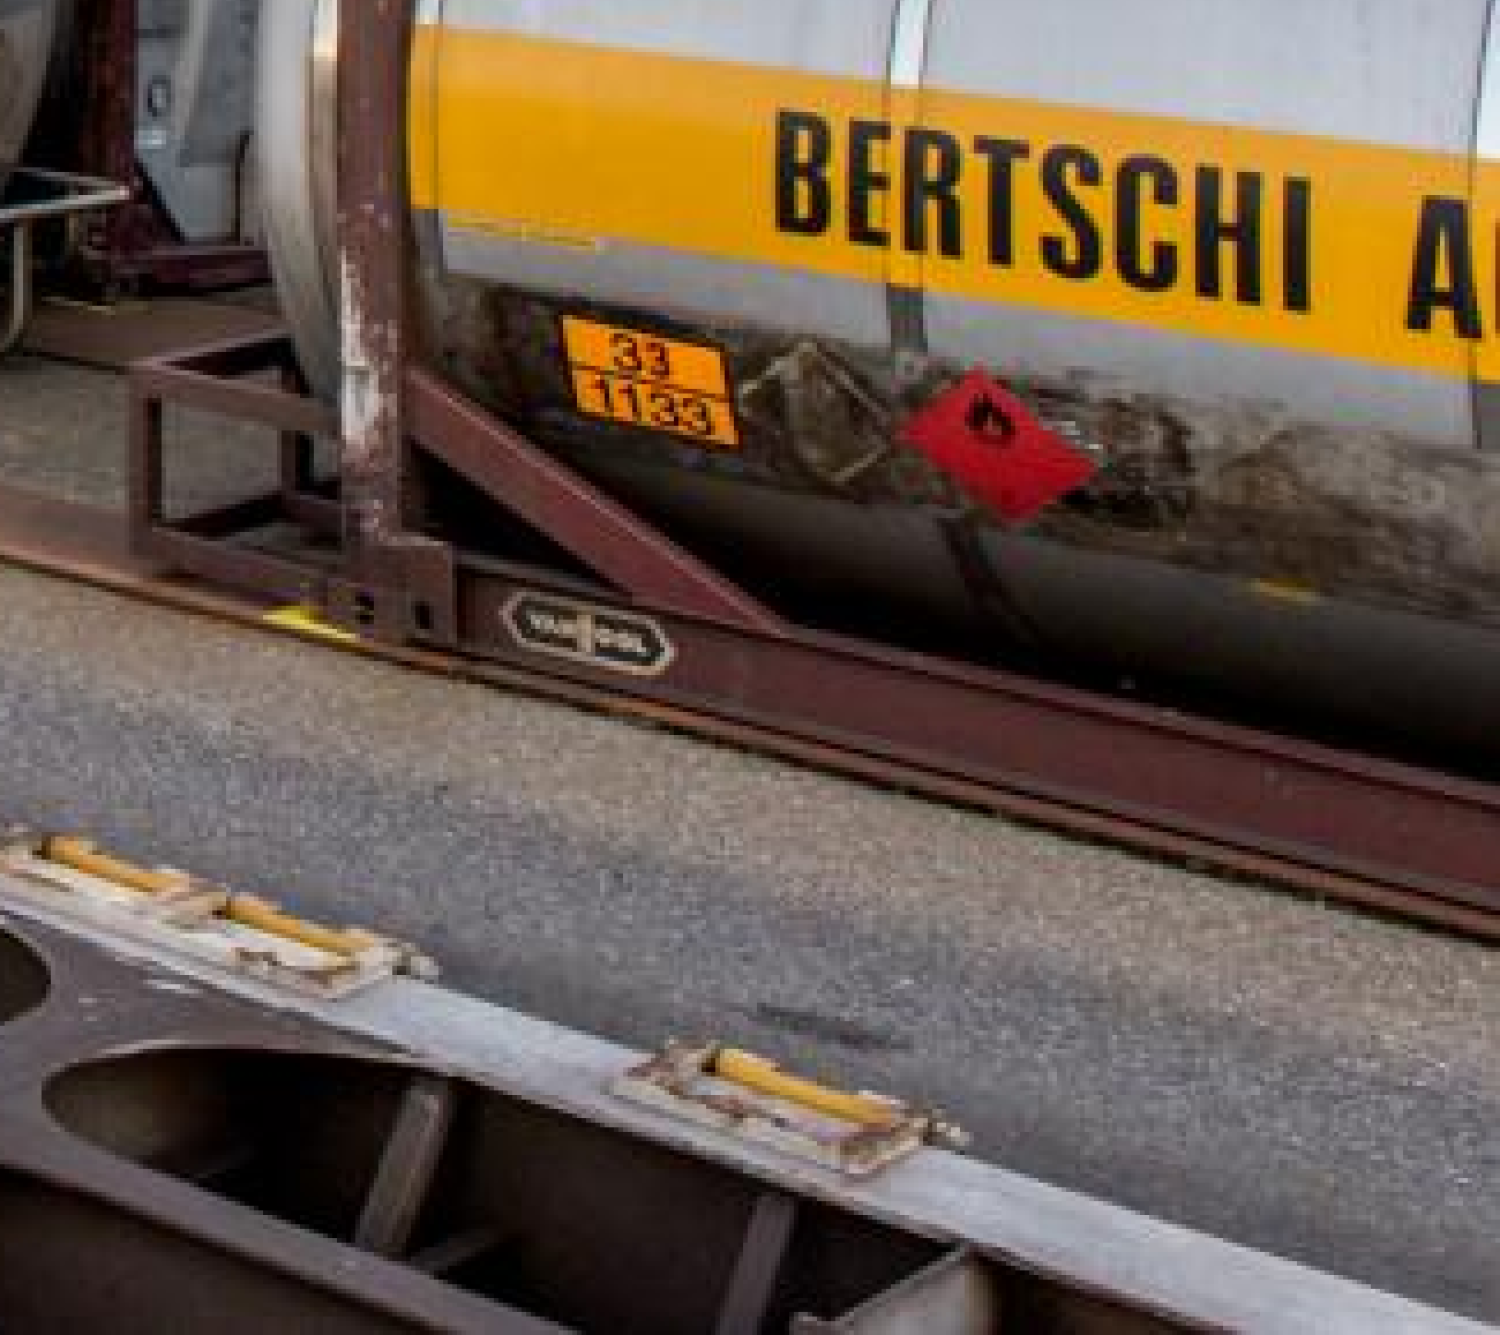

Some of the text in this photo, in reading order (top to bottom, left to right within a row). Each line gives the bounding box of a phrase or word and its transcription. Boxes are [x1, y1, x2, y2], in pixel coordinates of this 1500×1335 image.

[775, 105, 1500, 345] BERTSCHI A
[610, 332, 671, 379] 33
[594, 377, 716, 437] 1133
